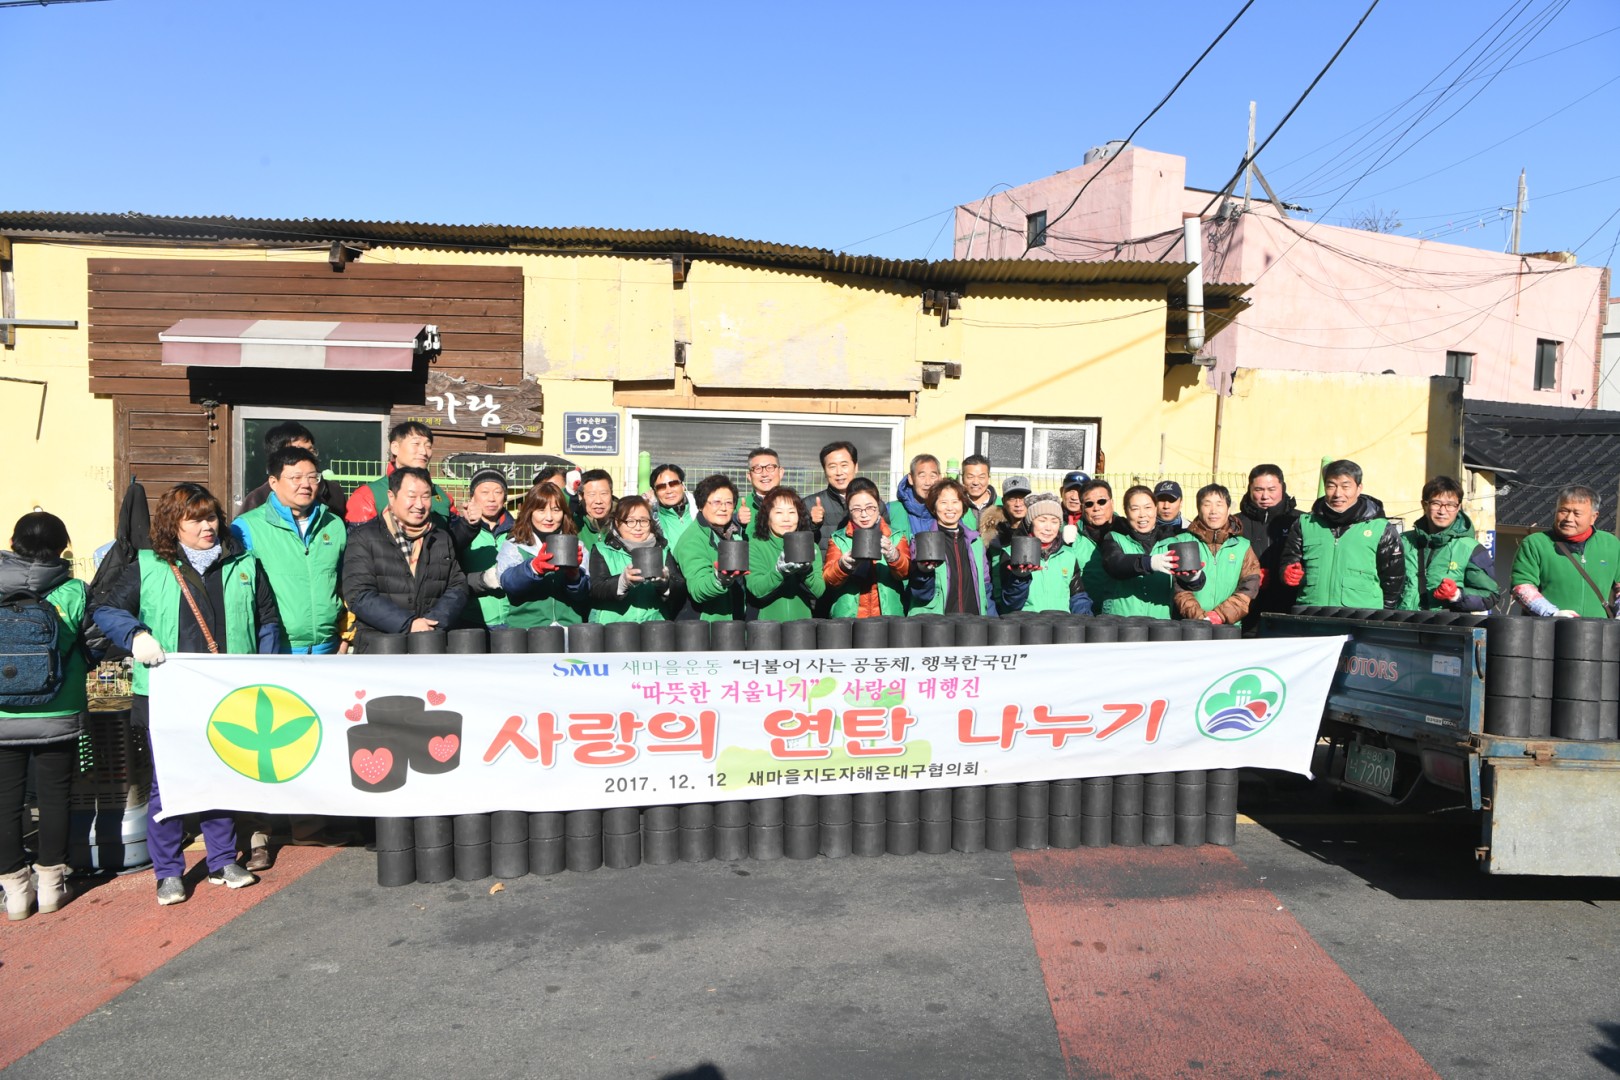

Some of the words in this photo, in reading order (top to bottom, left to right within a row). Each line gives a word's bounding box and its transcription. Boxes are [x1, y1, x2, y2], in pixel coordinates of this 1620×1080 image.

[427, 392, 501, 427] 가람
[575, 417, 607, 425] 반송순환로
[575, 426, 608, 443] 69
[553, 661, 610, 677] SMU
[621, 659, 722, 676] 새마을운동
[806, 657, 846, 673] 사는
[842, 677, 906, 701] 사랑의
[918, 676, 981, 699] 대행진
[482, 710, 720, 768] 사랑의
[762, 706, 917, 760] 연탄
[956, 698, 1169, 751] 나누기
[707, 773, 727, 787] 12
[1359, 760, 1391, 788] 7209
